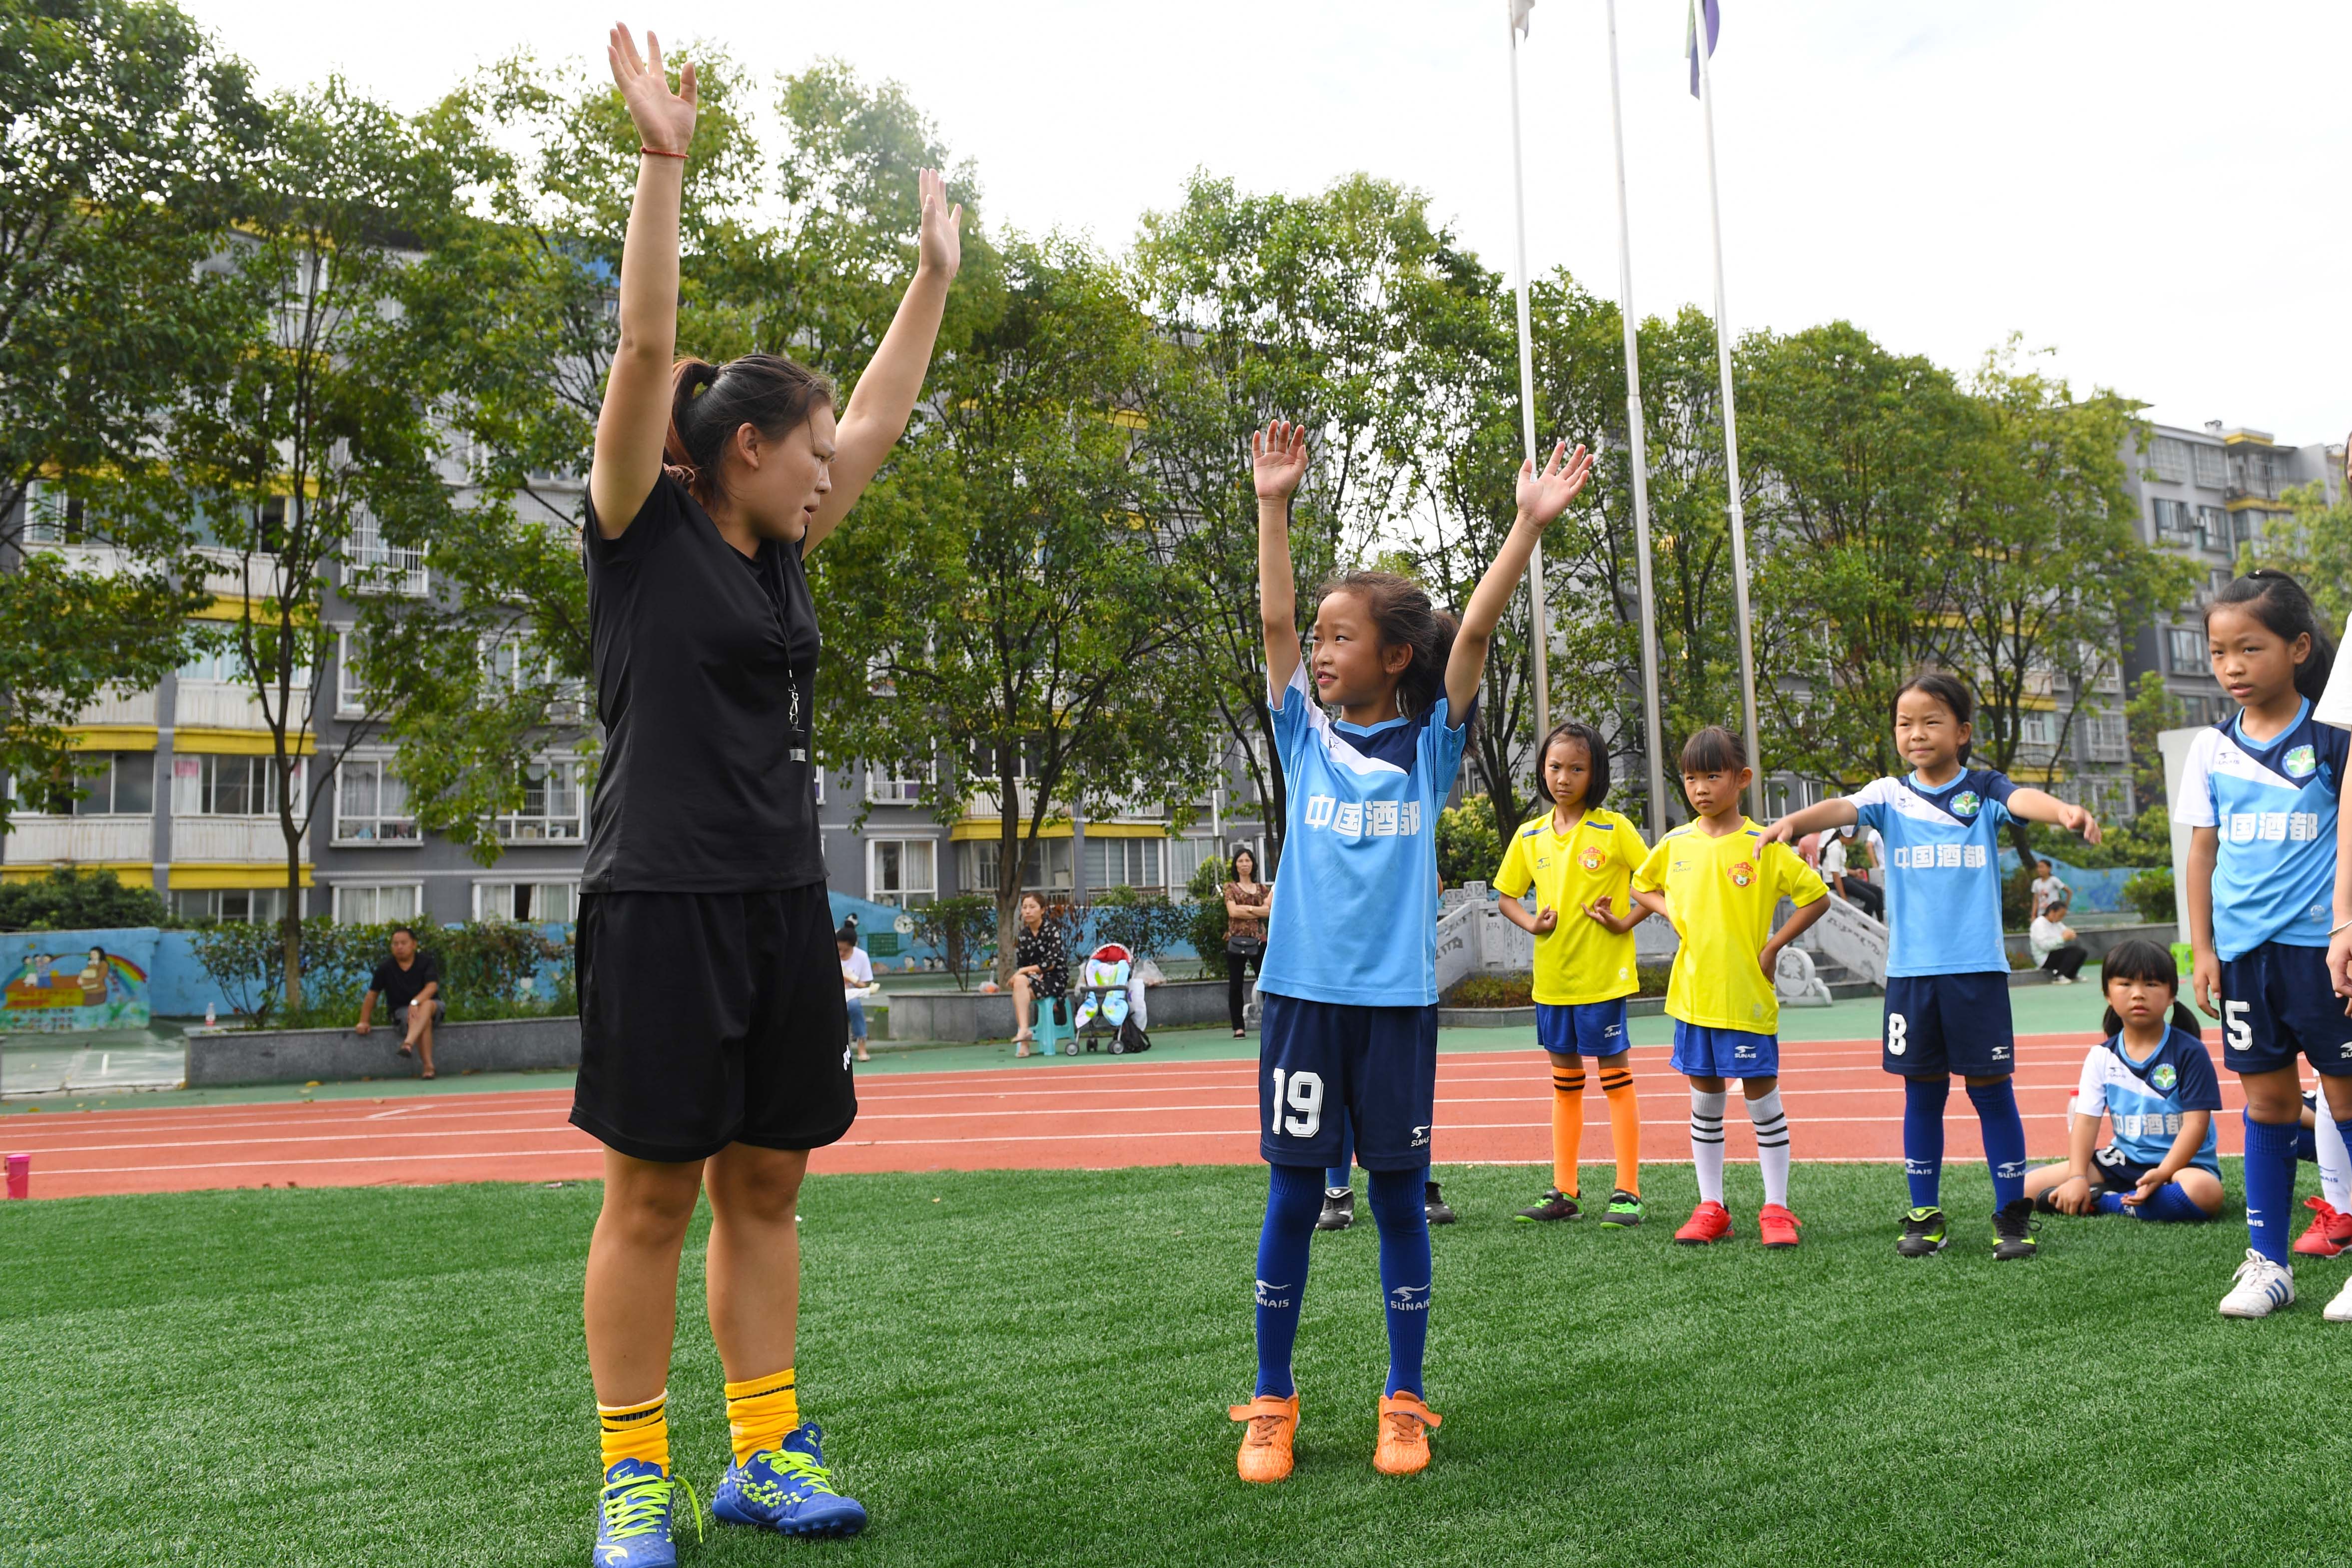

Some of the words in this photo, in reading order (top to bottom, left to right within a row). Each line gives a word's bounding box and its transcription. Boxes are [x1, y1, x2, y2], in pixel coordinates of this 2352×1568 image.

[1304, 793, 1421, 837] 中国酒都
[1894, 844, 1987, 869] 中国酒都
[1888, 1012, 1907, 1055] 8
[2225, 1000, 2253, 1051] 5
[1272, 1067, 1324, 1138] 19
